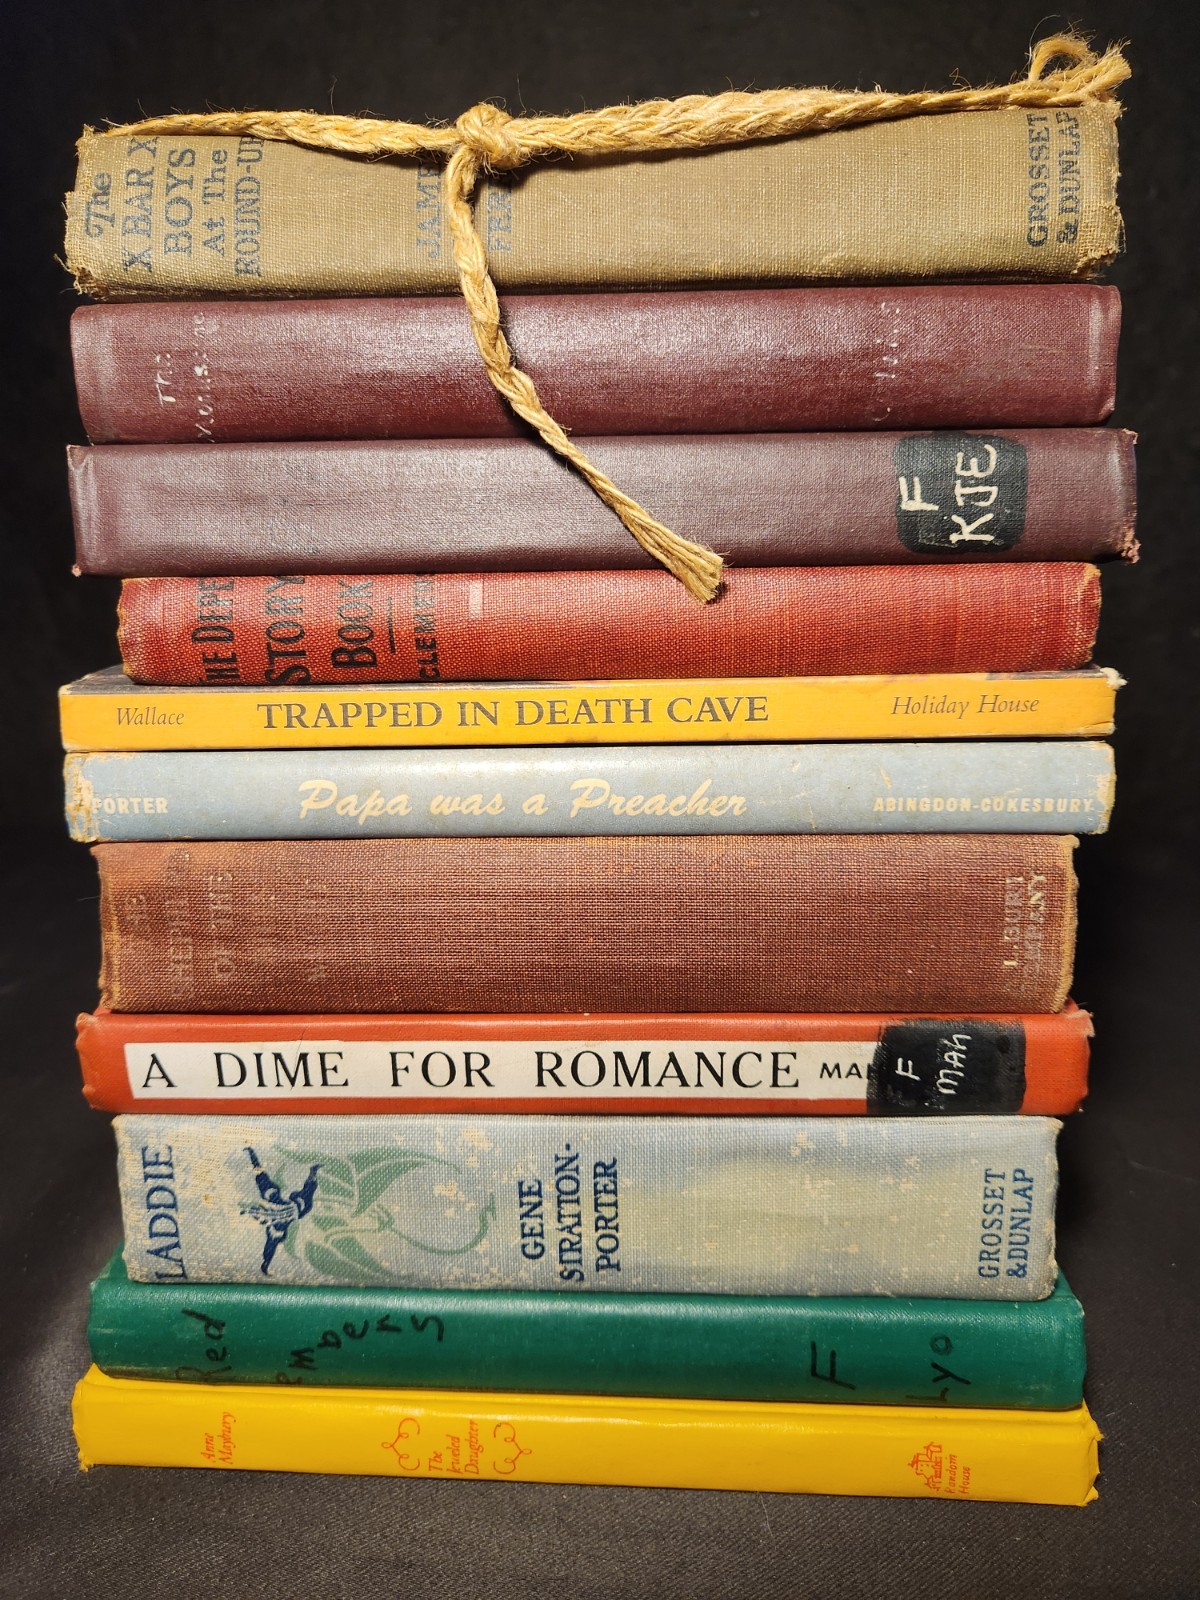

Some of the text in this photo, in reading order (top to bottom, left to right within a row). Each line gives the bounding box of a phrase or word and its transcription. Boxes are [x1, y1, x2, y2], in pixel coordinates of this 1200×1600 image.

[85, 171, 116, 239] The
[121, 137, 160, 273] X BAR X
[164, 148, 197, 257] BOYS
[202, 149, 228, 257] At The
[1026, 112, 1050, 248] GROSSET
[1055, 111, 1081, 244] & DUNLAP
[899, 476, 940, 511] F
[949, 443, 998, 543] KJE
[265, 575, 312, 685] STORY
[331, 579, 378, 668] BOOK
[116, 706, 185, 726] Wallace
[257, 696, 769, 729] TRAPPED IN DEATH CAVE
[891, 694, 1040, 720] Holiday House
[92, 797, 168, 814] PORTER
[298, 778, 748, 826] Papa was a Preacher
[873, 797, 1095, 813] ABINGDON-COKESBURY
[142, 1053, 177, 1088] A
[213, 1051, 349, 1088] DIME
[390, 1050, 495, 1087] FOR
[535, 1050, 799, 1089] ROMANCE
[895, 1057, 921, 1081] F
[141, 1144, 187, 1281] LADDIE
[520, 1179, 546, 1261] GENE
[556, 1143, 585, 1283] STRATTON-
[595, 1157, 623, 1273] PORTER
[978, 1168, 1005, 1279] GROSSET
[175, 1308, 232, 1384] Red
[811, 1340, 856, 1390] F
[200, 1432, 216, 1464] Anne
[217, 1411, 237, 1465] Maybury
[428, 1451, 443, 1472] The
[464, 1419, 484, 1475] Daughter
[945, 1454, 958, 1494] Random
[961, 1465, 971, 1495] House
